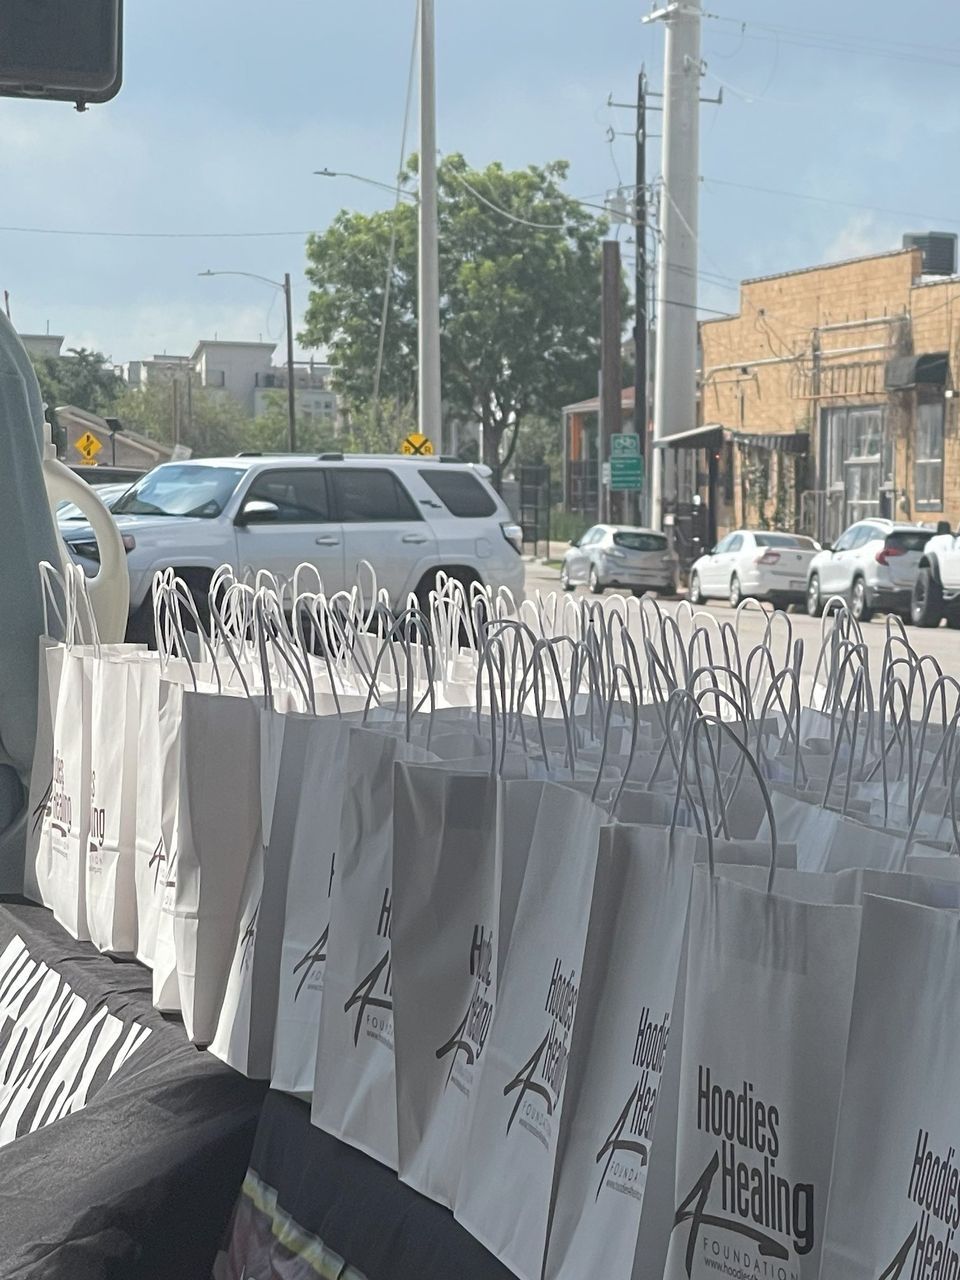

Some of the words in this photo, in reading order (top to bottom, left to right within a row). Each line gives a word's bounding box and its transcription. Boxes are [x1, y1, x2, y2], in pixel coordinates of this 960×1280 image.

[697, 1065, 779, 1158] Hoodies
[673, 1149, 789, 1280] 4
[721, 1139, 814, 1256] Healing
